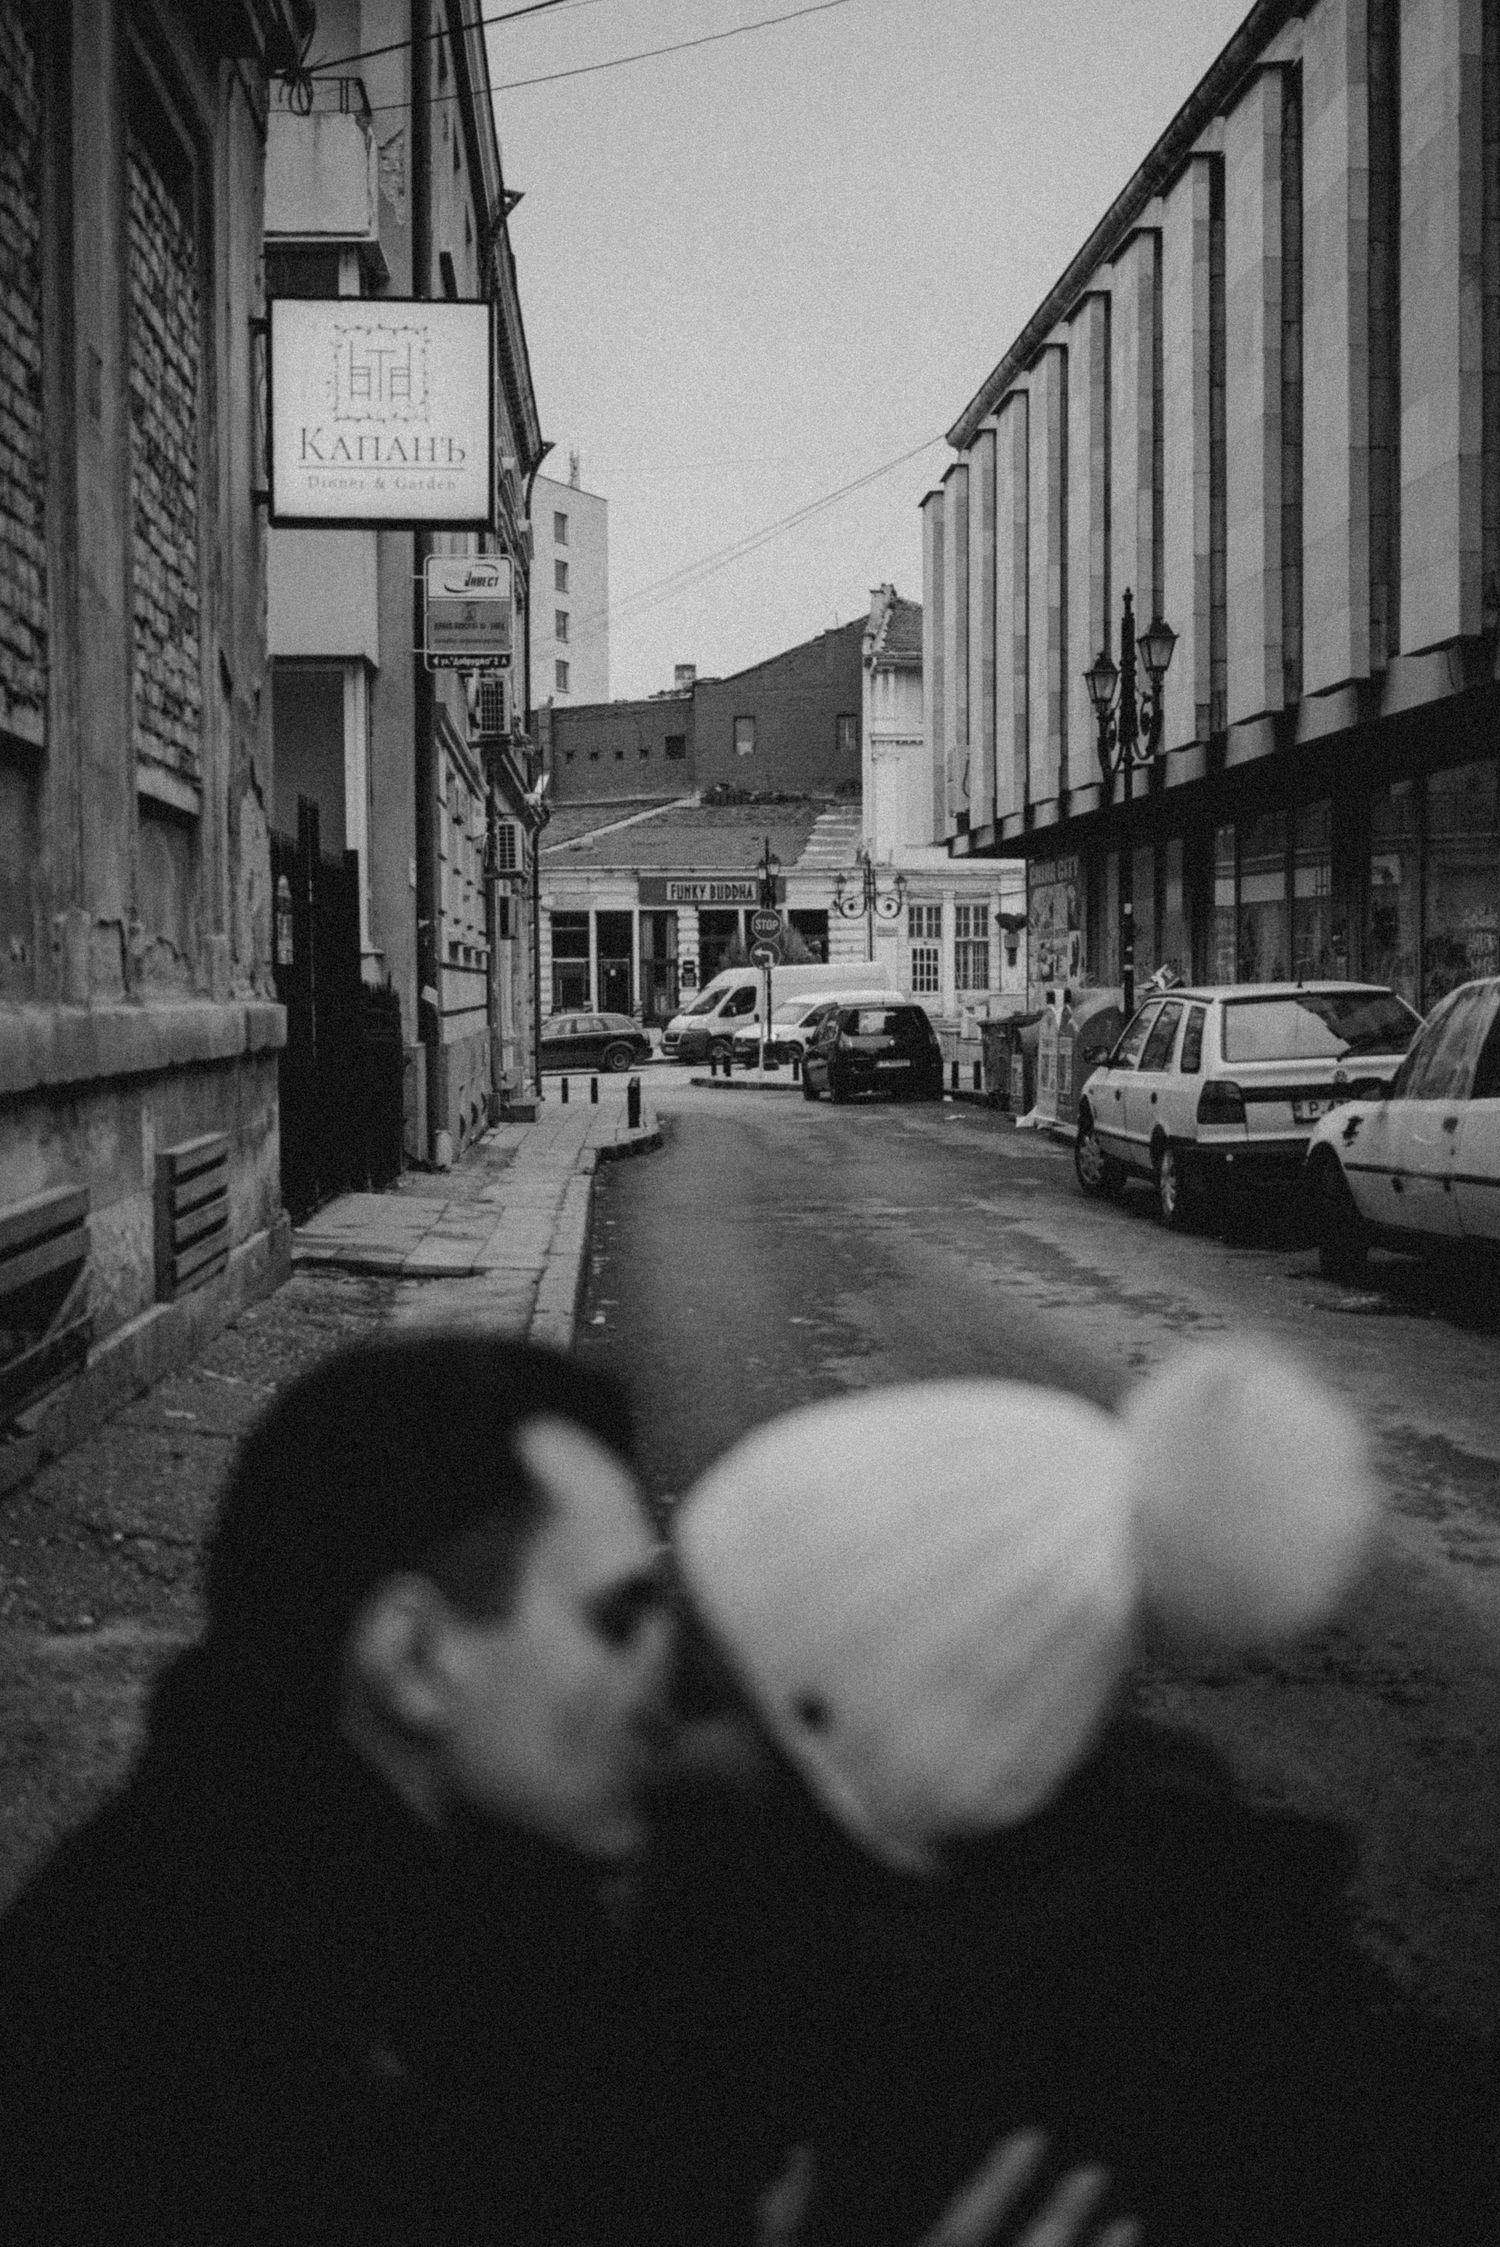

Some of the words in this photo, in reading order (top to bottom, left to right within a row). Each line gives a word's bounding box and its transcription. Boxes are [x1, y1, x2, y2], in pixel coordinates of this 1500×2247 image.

[307, 475, 365, 489] Dinner
[374, 476, 386, 490] &
[394, 476, 457, 490] Garden
[671, 884, 706, 899] FUNKY
[710, 883, 753, 899] BUDDHA
[755, 919, 778, 931] STOP
